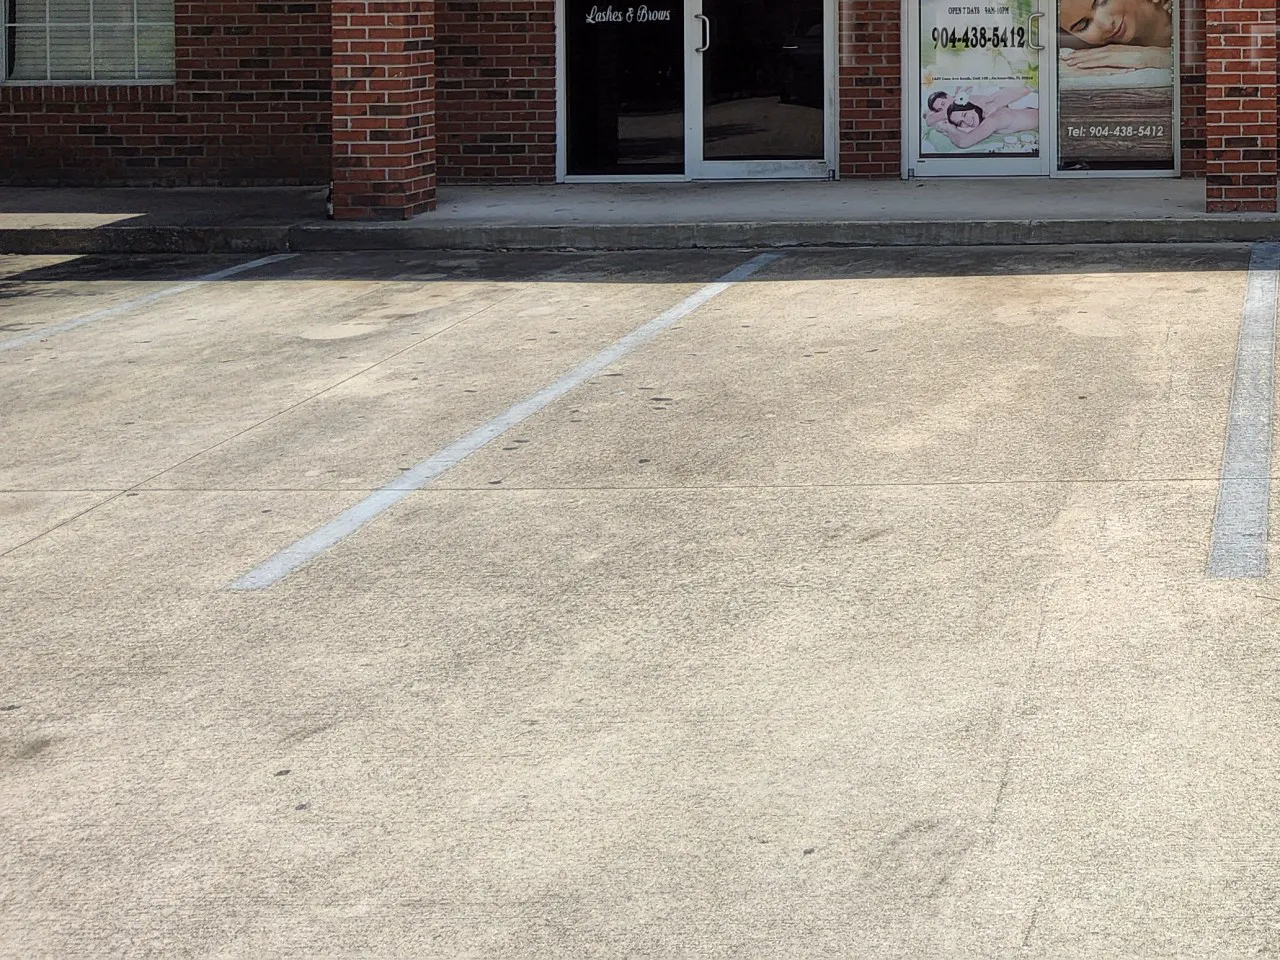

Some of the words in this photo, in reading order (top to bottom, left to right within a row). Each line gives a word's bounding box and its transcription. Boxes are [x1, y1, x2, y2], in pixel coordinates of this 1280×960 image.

[585, 5, 624, 24] Lashes
[625, 7, 634, 23] &
[636, 4, 672, 22] Brows
[948, 6, 962, 15] OPEN
[962, 6, 966, 15] 7
[966, 6, 980, 15] DAYS
[931, 26, 1026, 49] 904-438-5412
[1067, 126, 1086, 137] Tel:
[1089, 126, 1164, 137] 904-438-5412
